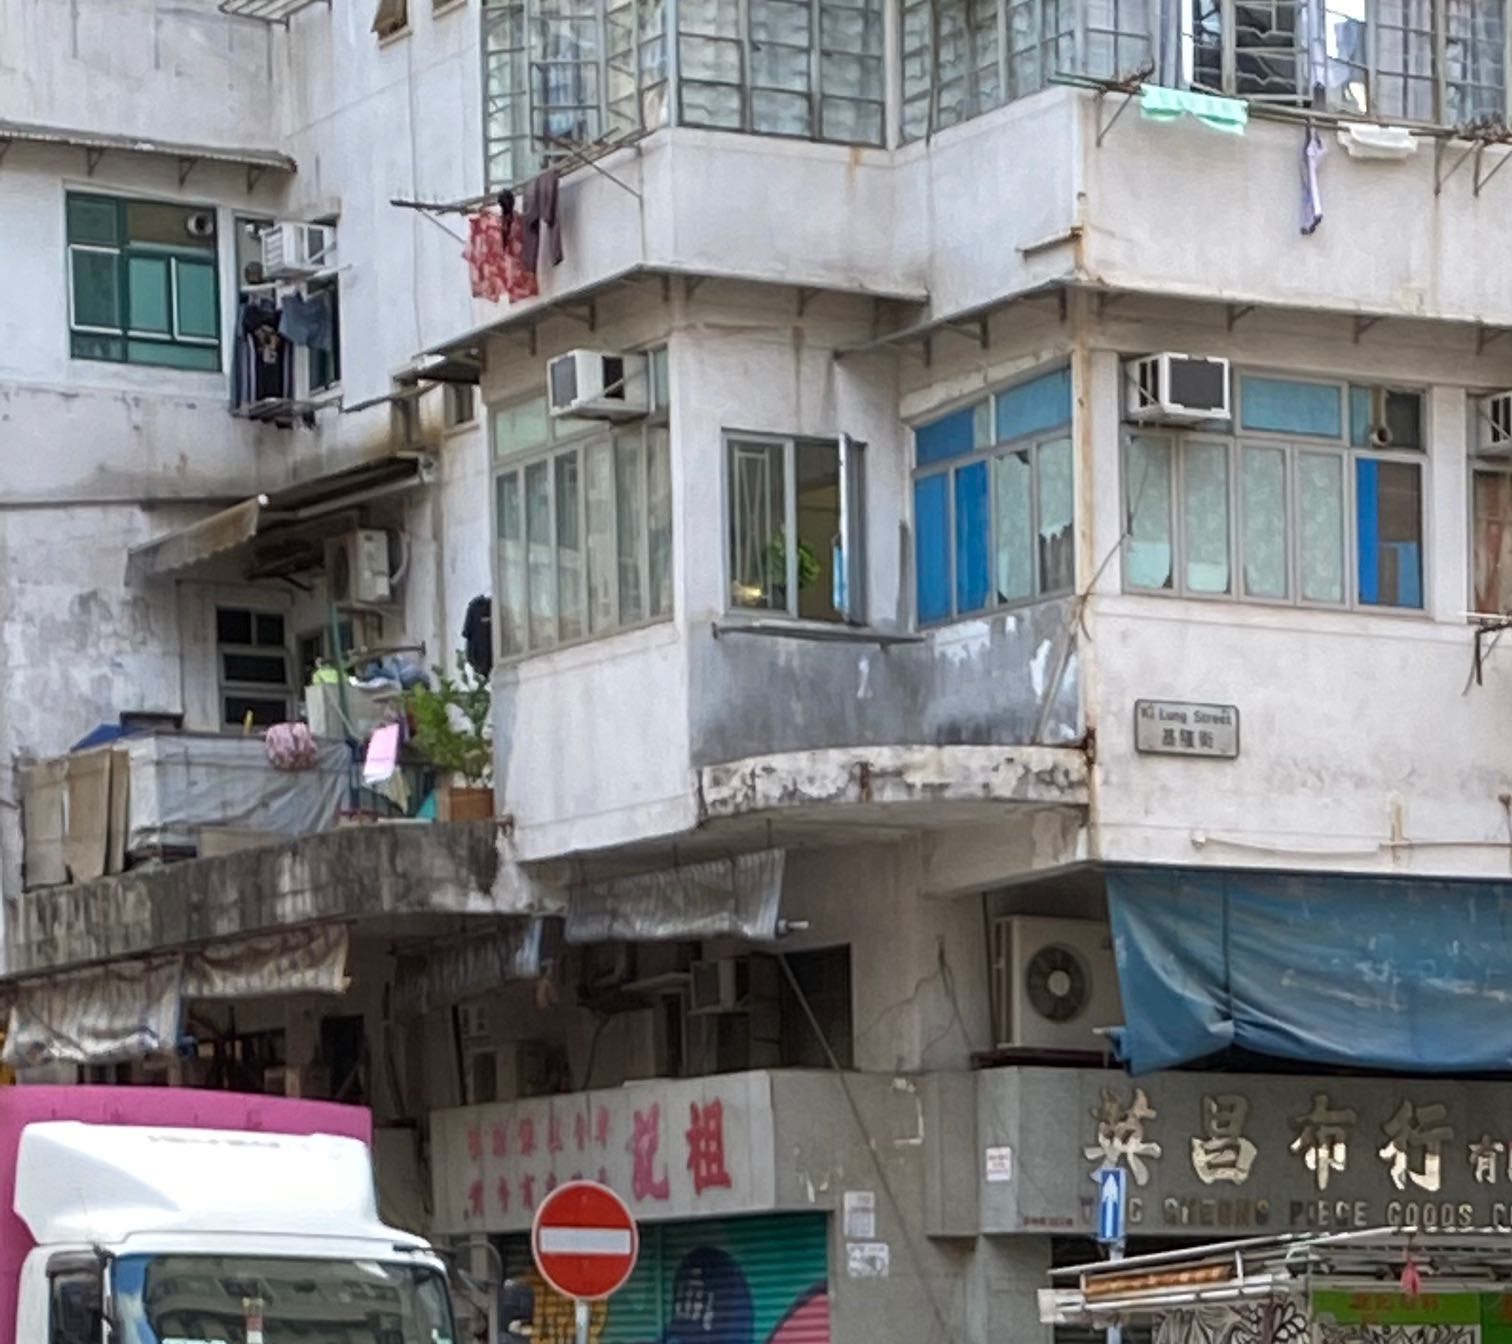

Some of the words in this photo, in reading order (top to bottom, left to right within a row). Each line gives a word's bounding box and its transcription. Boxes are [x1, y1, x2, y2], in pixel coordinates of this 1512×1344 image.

[1159, 708, 1187, 724] Lung
[1193, 709, 1232, 725] Street
[1386, 1200, 1474, 1228] GOODS
